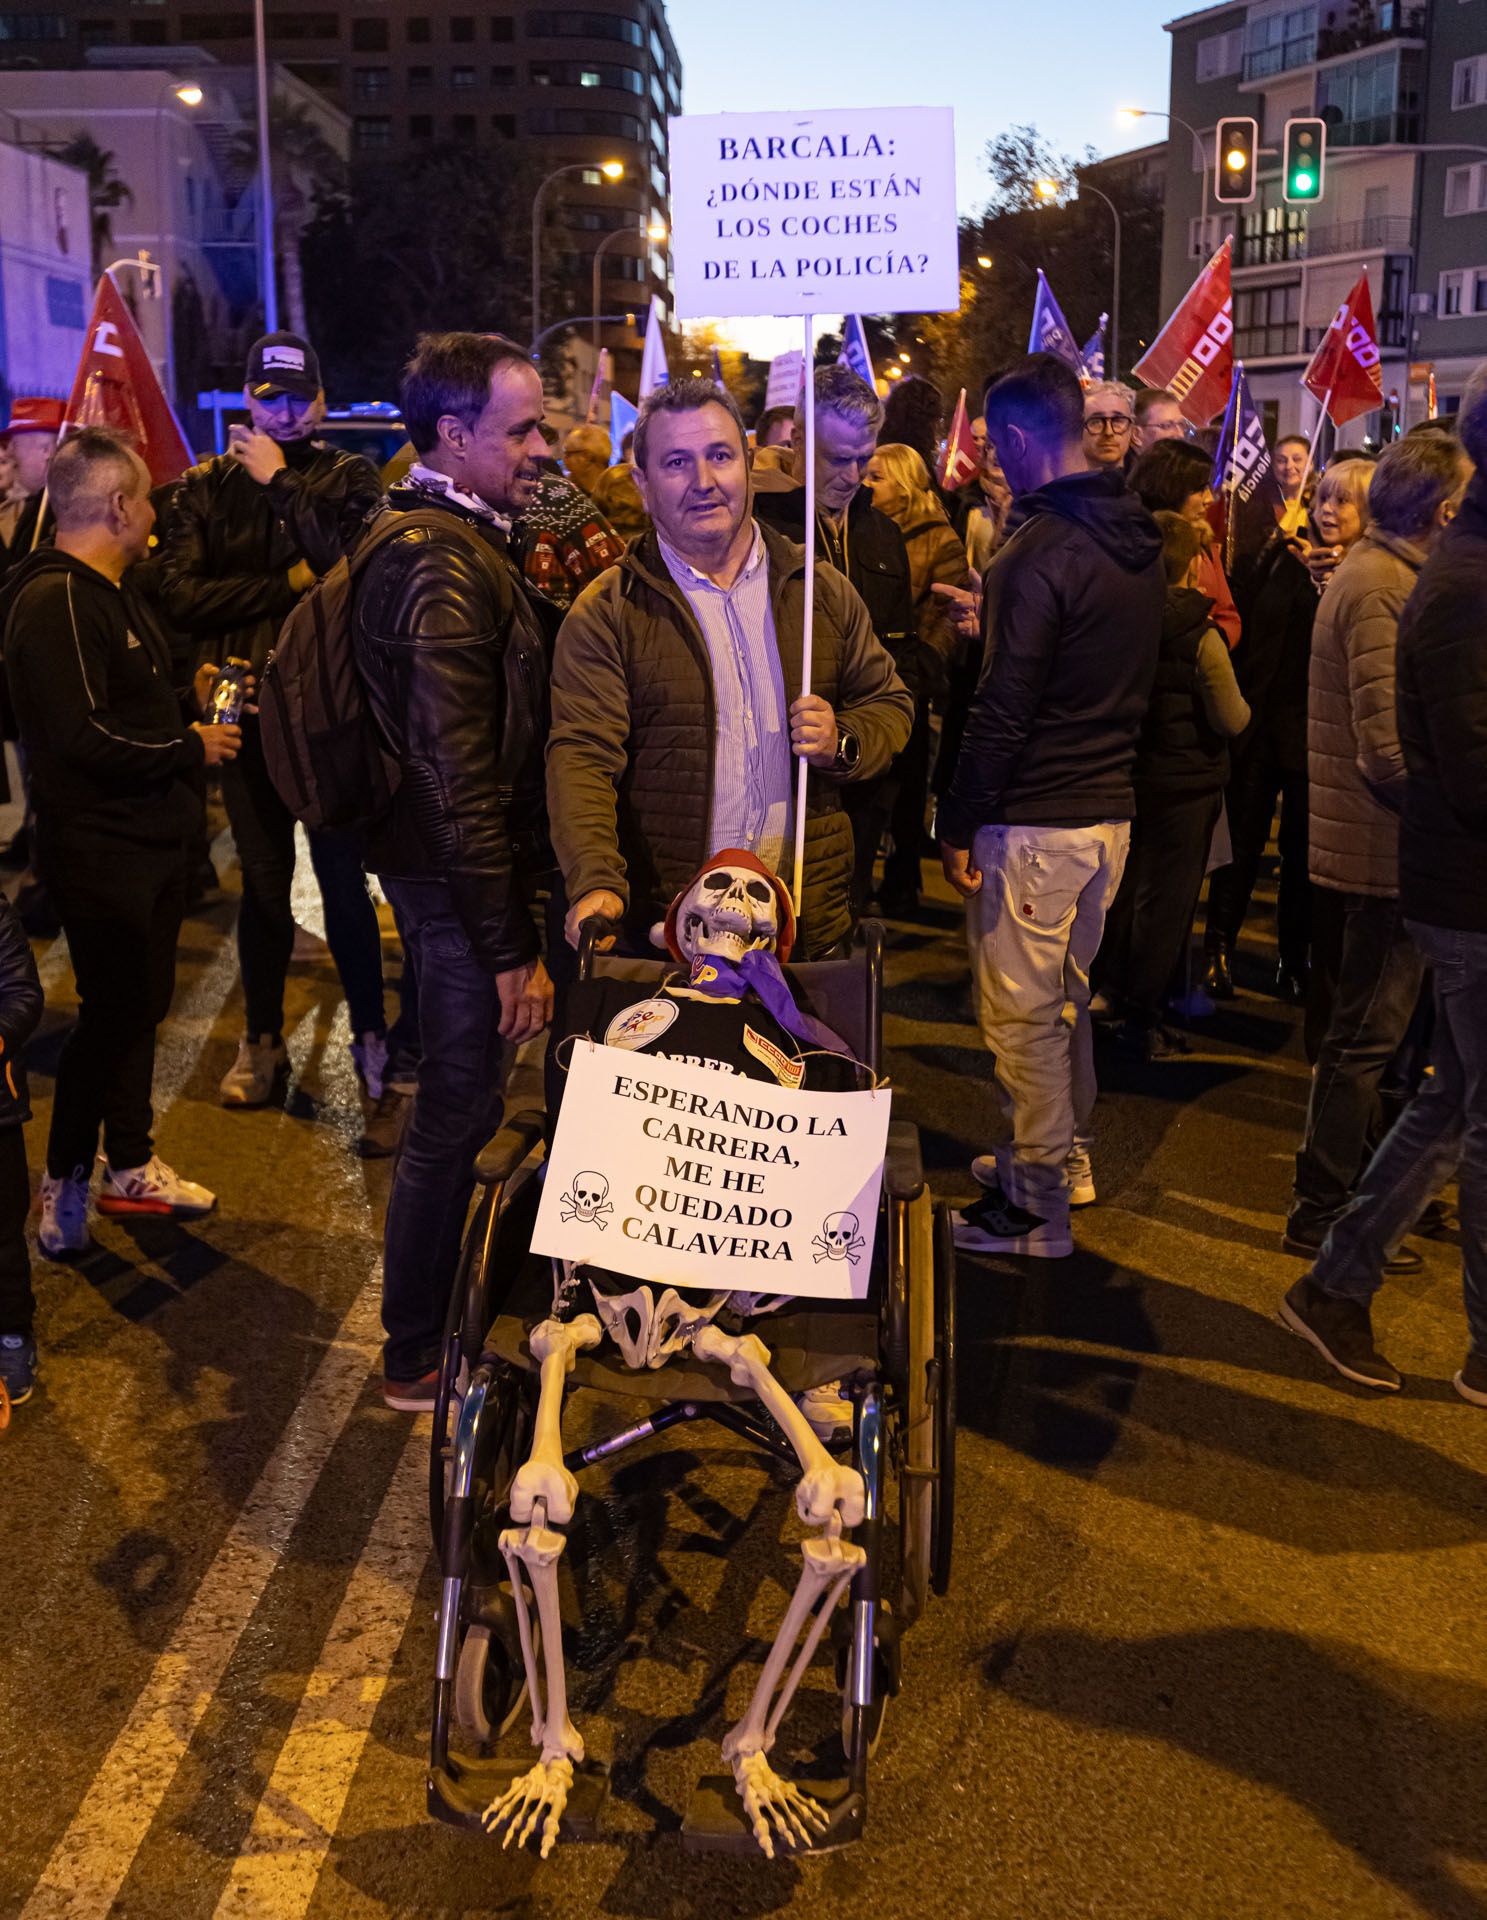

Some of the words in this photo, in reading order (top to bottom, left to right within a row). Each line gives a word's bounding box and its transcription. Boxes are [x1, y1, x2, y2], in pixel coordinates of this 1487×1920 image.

[718, 133, 896, 161] BARCALA:
[706, 177, 820, 208] ¿DÓNDE
[830, 172, 923, 200] ESTÁN
[716, 217, 772, 239] LOS
[781, 213, 899, 237] COCHES
[703, 260, 741, 281] DE
[750, 259, 788, 280] LA
[796, 250, 930, 278] POLICÍA?
[612, 1075, 799, 1134] ESPERANDO
[806, 1117, 848, 1137] LA
[642, 1117, 800, 1169] CARRERA,
[663, 1156, 713, 1186] ME
[720, 1169, 766, 1194] HE
[634, 1184, 793, 1228] QUEDADO
[621, 1217, 793, 1262] CALAVERA
